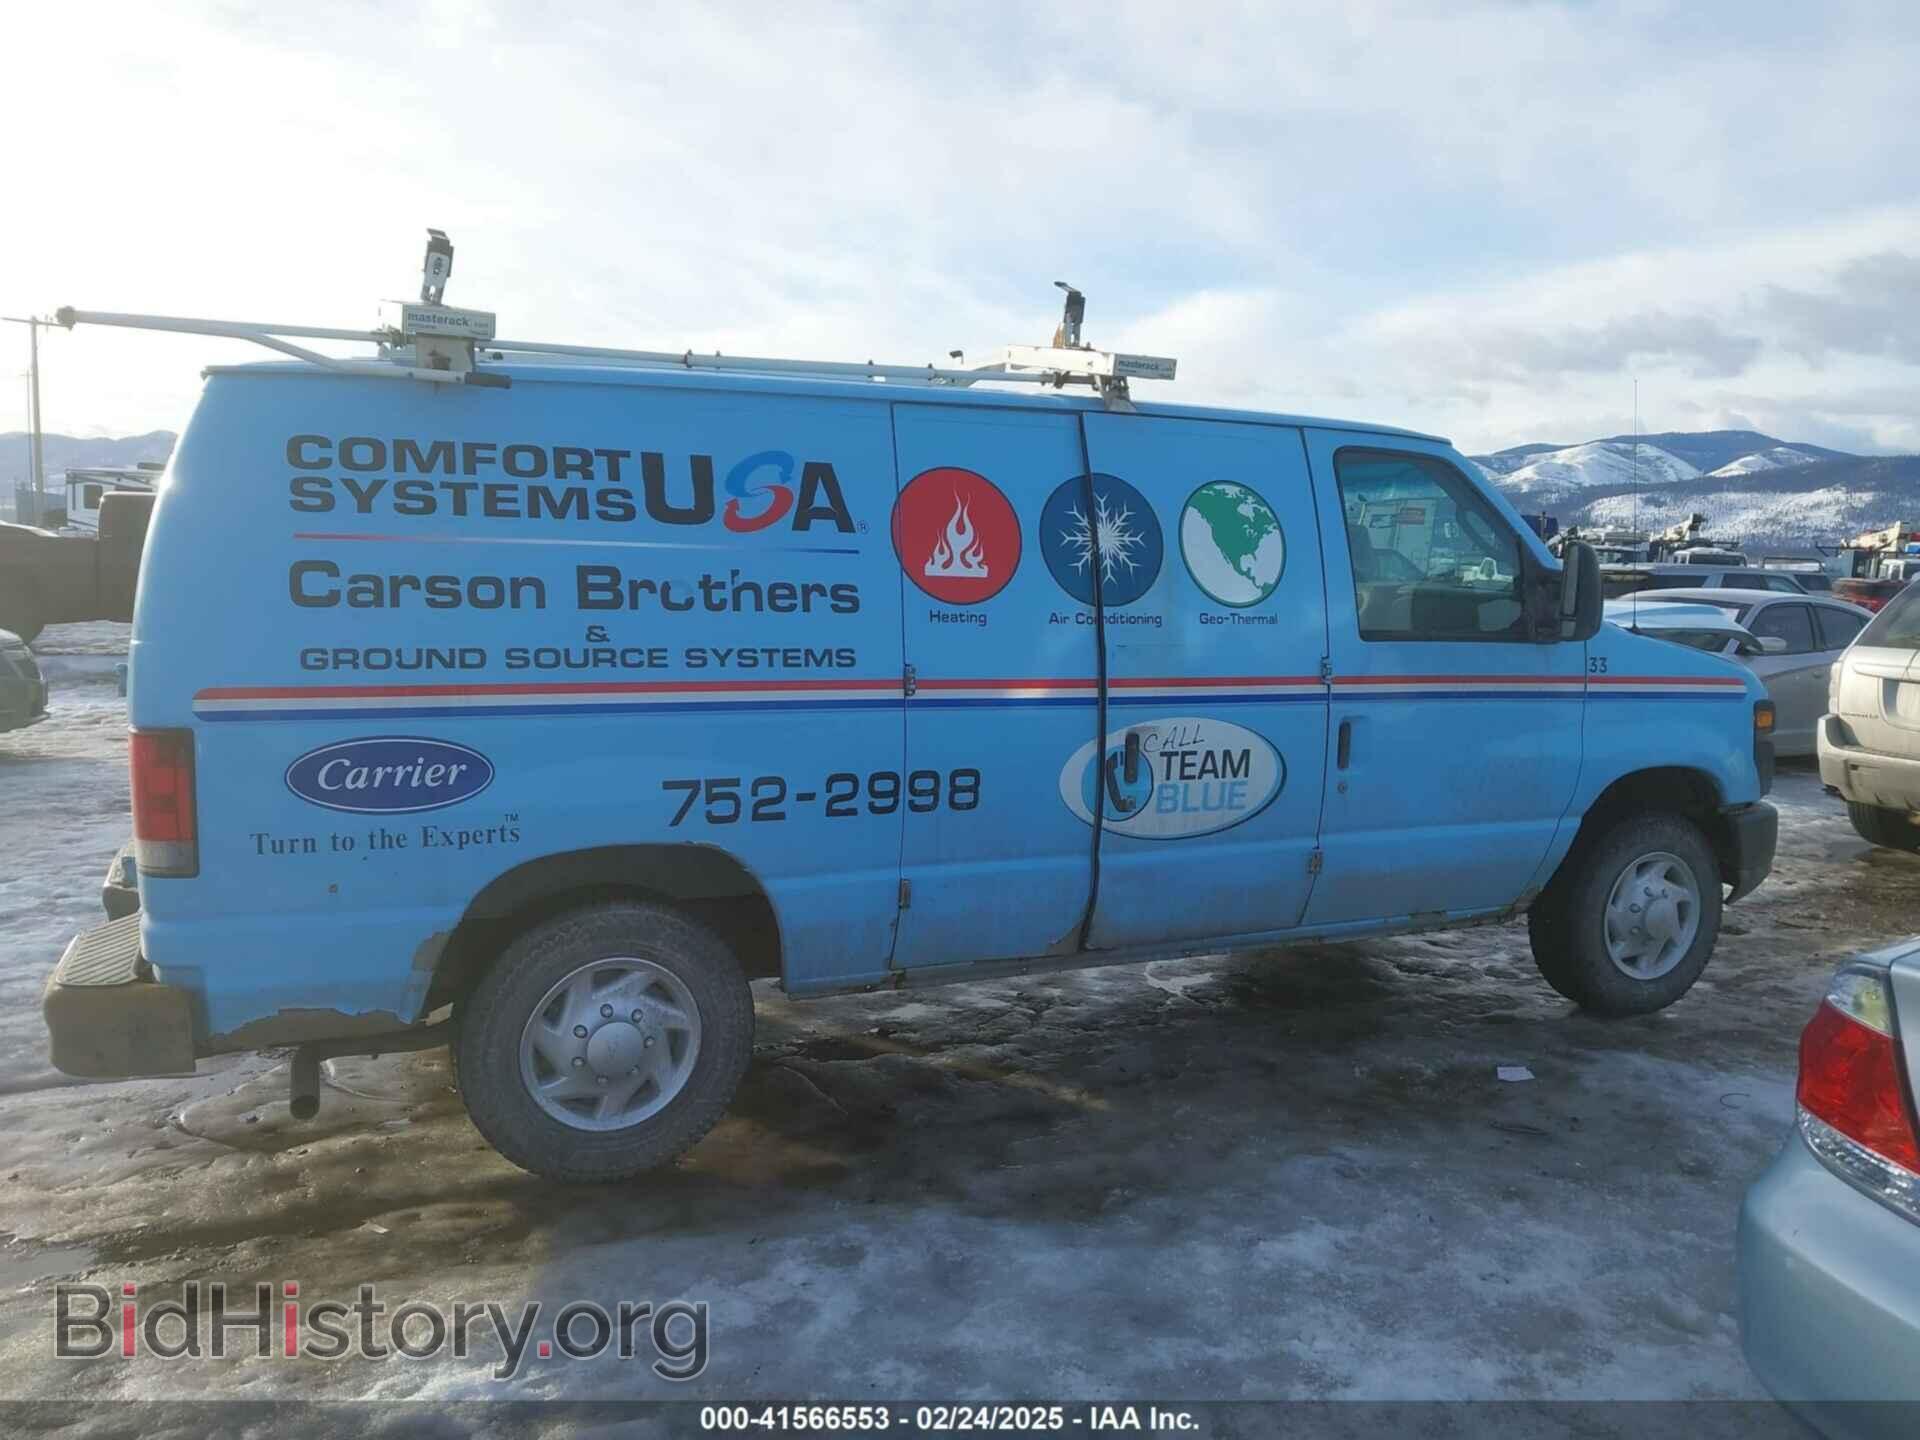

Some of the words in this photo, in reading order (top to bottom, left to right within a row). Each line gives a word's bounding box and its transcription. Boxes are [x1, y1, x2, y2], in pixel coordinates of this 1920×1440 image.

[286, 434, 632, 482] COMFORT
[289, 476, 637, 523] SYSTEMS
[640, 450, 857, 534] USA
[288, 559, 547, 610] Carson
[576, 564, 860, 614] Brothers
[585, 625, 610, 643] &
[929, 609, 988, 627] Heating
[1048, 612, 1070, 625] Air
[1198, 612, 1279, 626] Geo-Thermal
[300, 648, 487, 670] GROUND
[505, 648, 669, 670] SOURCE
[684, 648, 857, 669] SYSTEMS
[1588, 656, 1608, 673] 33
[1143, 724, 1205, 753] CALL
[317, 757, 467, 790] Carrier
[1159, 749, 1251, 780] TEAM
[662, 768, 982, 827] 752-2998
[1155, 781, 1249, 815] BLUE
[250, 832, 317, 856] Turn
[330, 832, 356, 853] to
[368, 829, 408, 850] the
[421, 822, 520, 851] Experts
